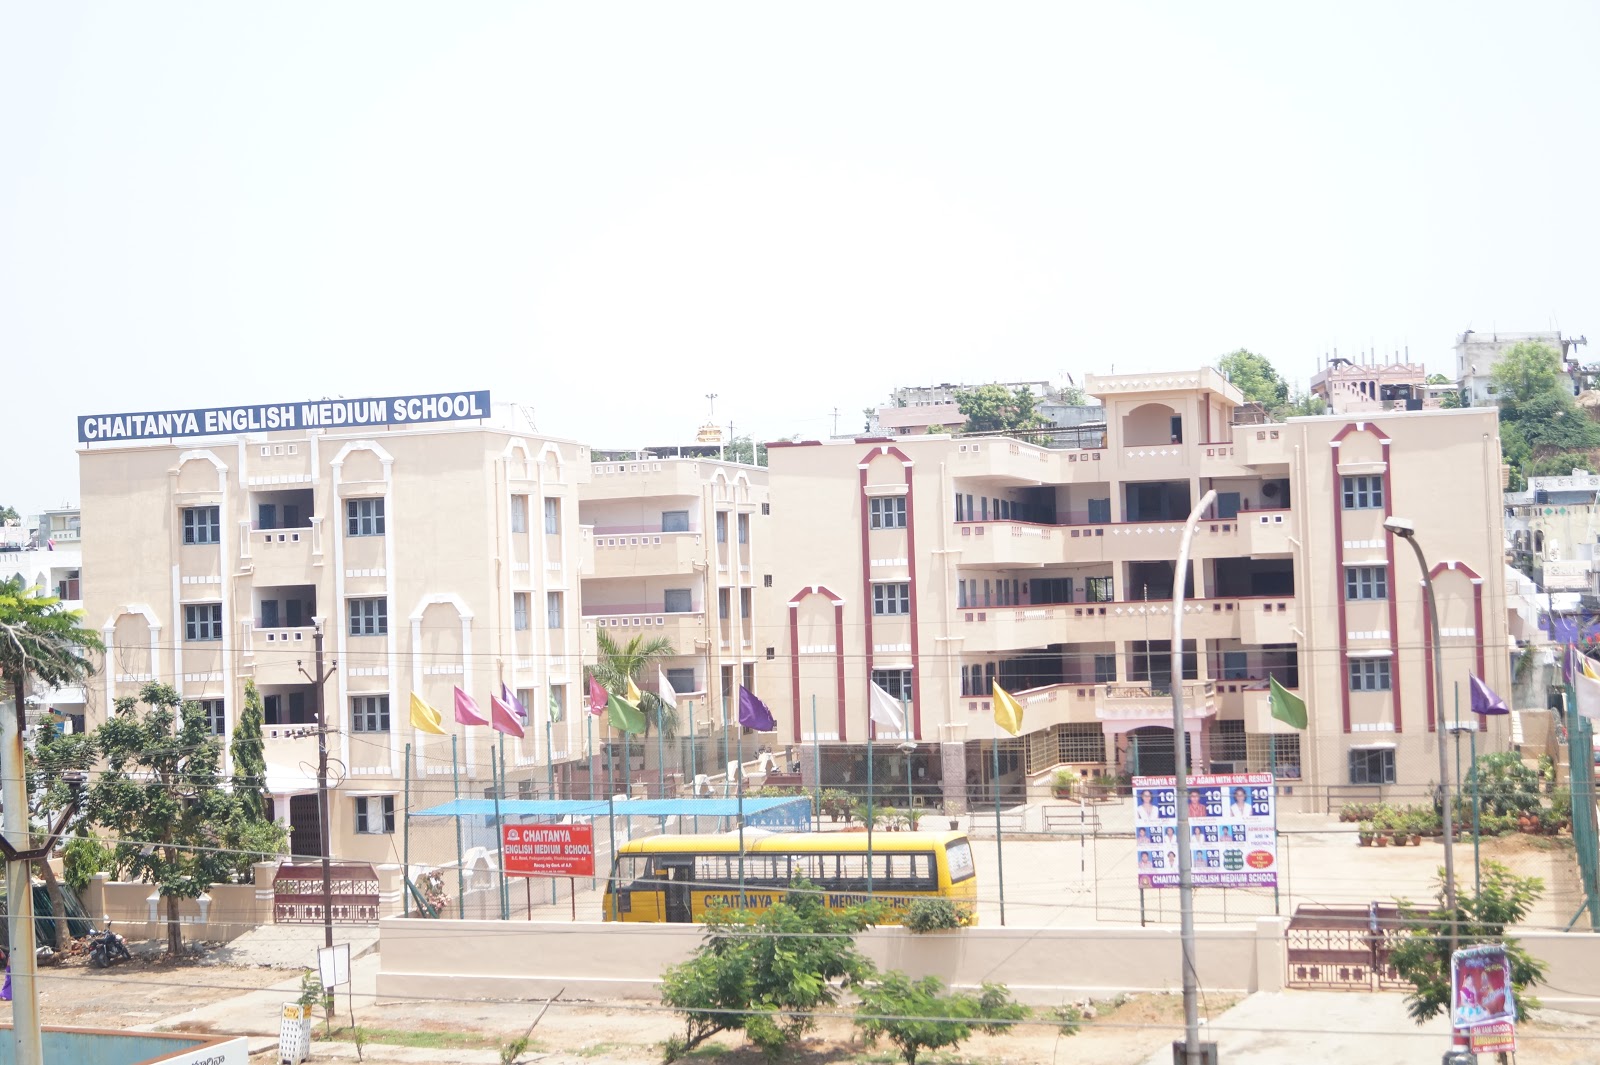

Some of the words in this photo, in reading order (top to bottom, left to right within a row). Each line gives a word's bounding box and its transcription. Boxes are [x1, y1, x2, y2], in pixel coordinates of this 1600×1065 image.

[84, 412, 199, 439] CHAITANYA
[204, 405, 295, 432] ENGLISH
[302, 400, 387, 426] MEDIUM
[393, 394, 482, 421] SCHOOL
[1197, 776, 1214, 785] AGAIN
[1216, 775, 1231, 784] WITH
[1249, 773, 1271, 783] RESULT
[1158, 791, 1175, 802] 10
[1205, 790, 1222, 800] 10
[1251, 789, 1268, 799] 10
[1158, 805, 1175, 816] 10
[1205, 804, 1222, 814] 10
[1252, 803, 1269, 813] 10
[1205, 825, 1217, 833] 9.8
[1232, 824, 1244, 832] 9.8
[523, 830, 571, 842] CHAITANYA
[1151, 835, 1162, 843] 10
[1206, 834, 1217, 842] 10
[1234, 833, 1244, 841] 10
[505, 844, 533, 855] ENGLISH
[534, 844, 561, 854] MEDIUM
[564, 844, 592, 855] SCHOOL
[1152, 850, 1164, 858] 9.8
[1206, 850, 1219, 858] 9.8
[1153, 860, 1163, 868] 10
[1208, 860, 1219, 868] 10
[1190, 873, 1219, 884] ENGLISH
[1220, 873, 1248, 883] MEDIUM
[1248, 872, 1276, 883] SCHOOL
